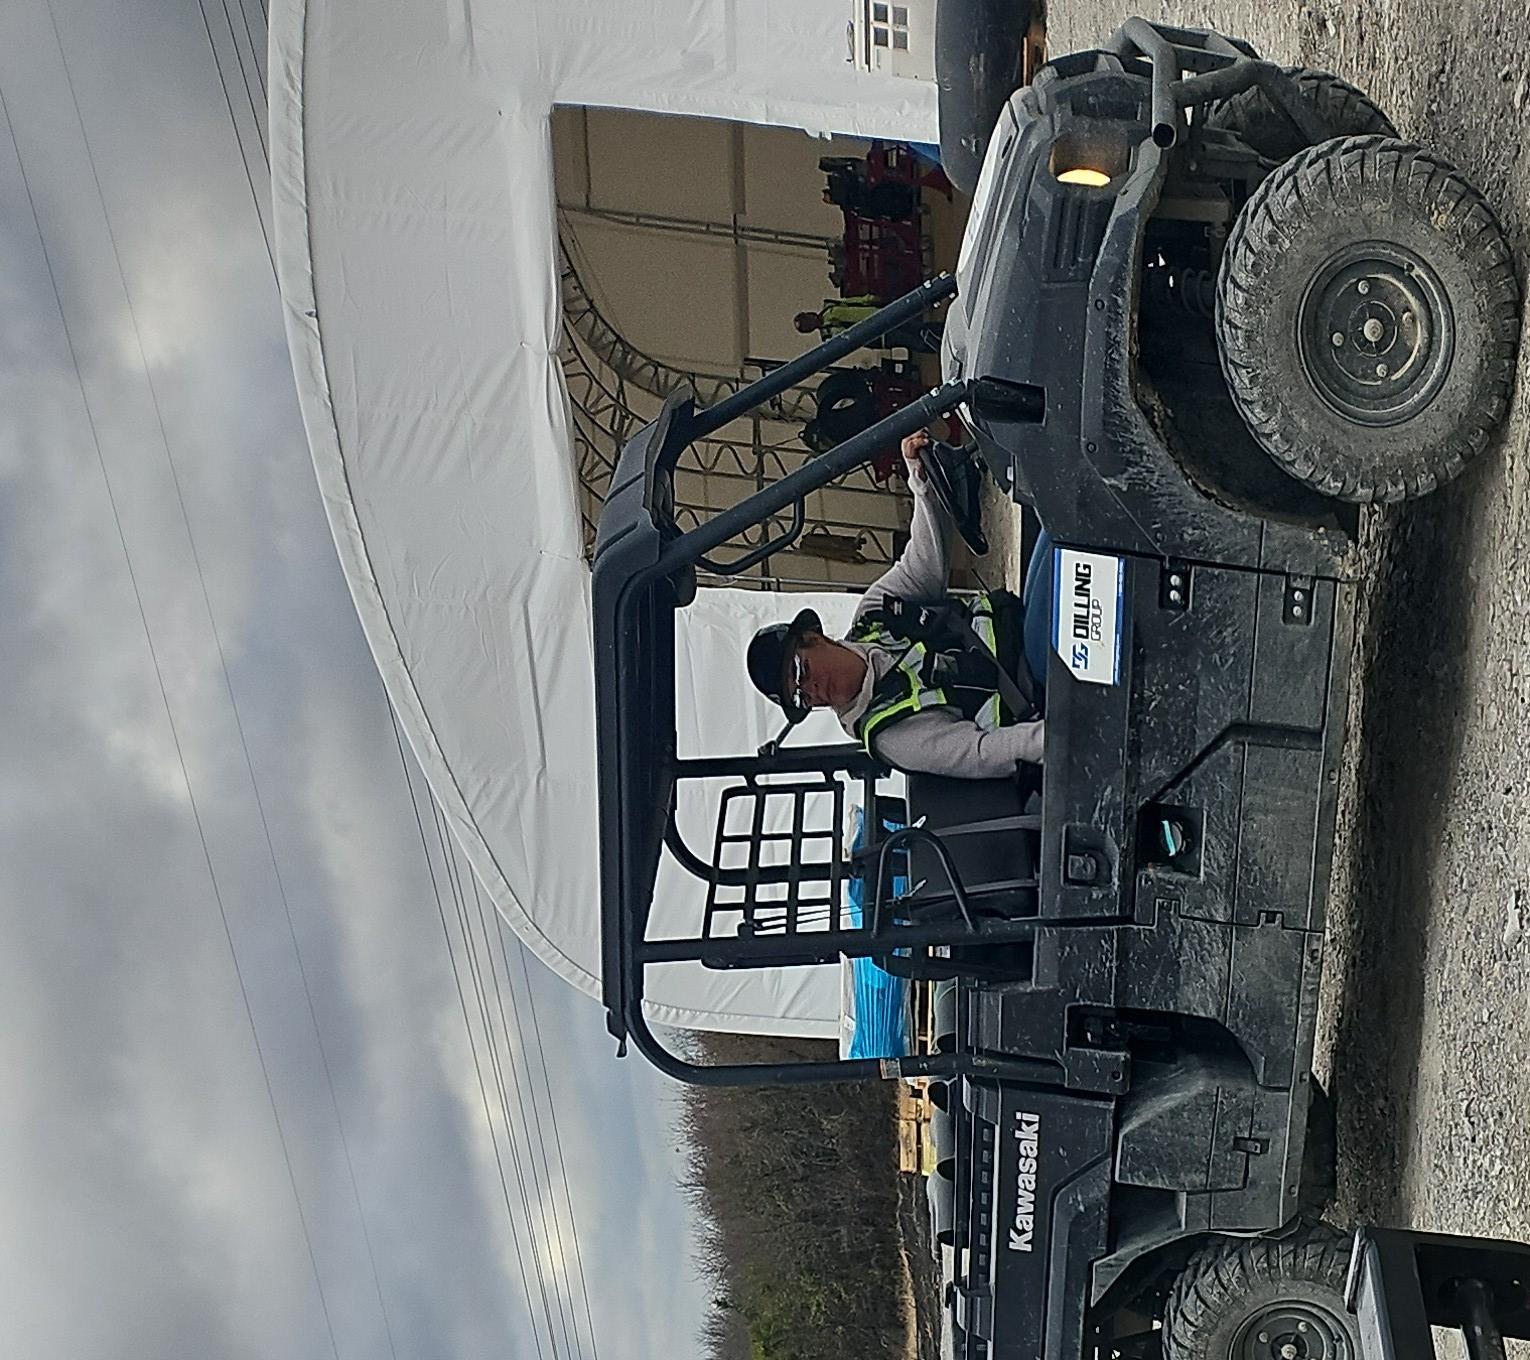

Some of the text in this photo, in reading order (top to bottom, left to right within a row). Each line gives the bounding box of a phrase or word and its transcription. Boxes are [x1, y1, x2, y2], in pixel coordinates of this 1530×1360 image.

[1073, 562, 1092, 640] DILLING
[1090, 598, 1102, 641] GROUP
[1008, 1112, 1040, 1252] Kawasaki
